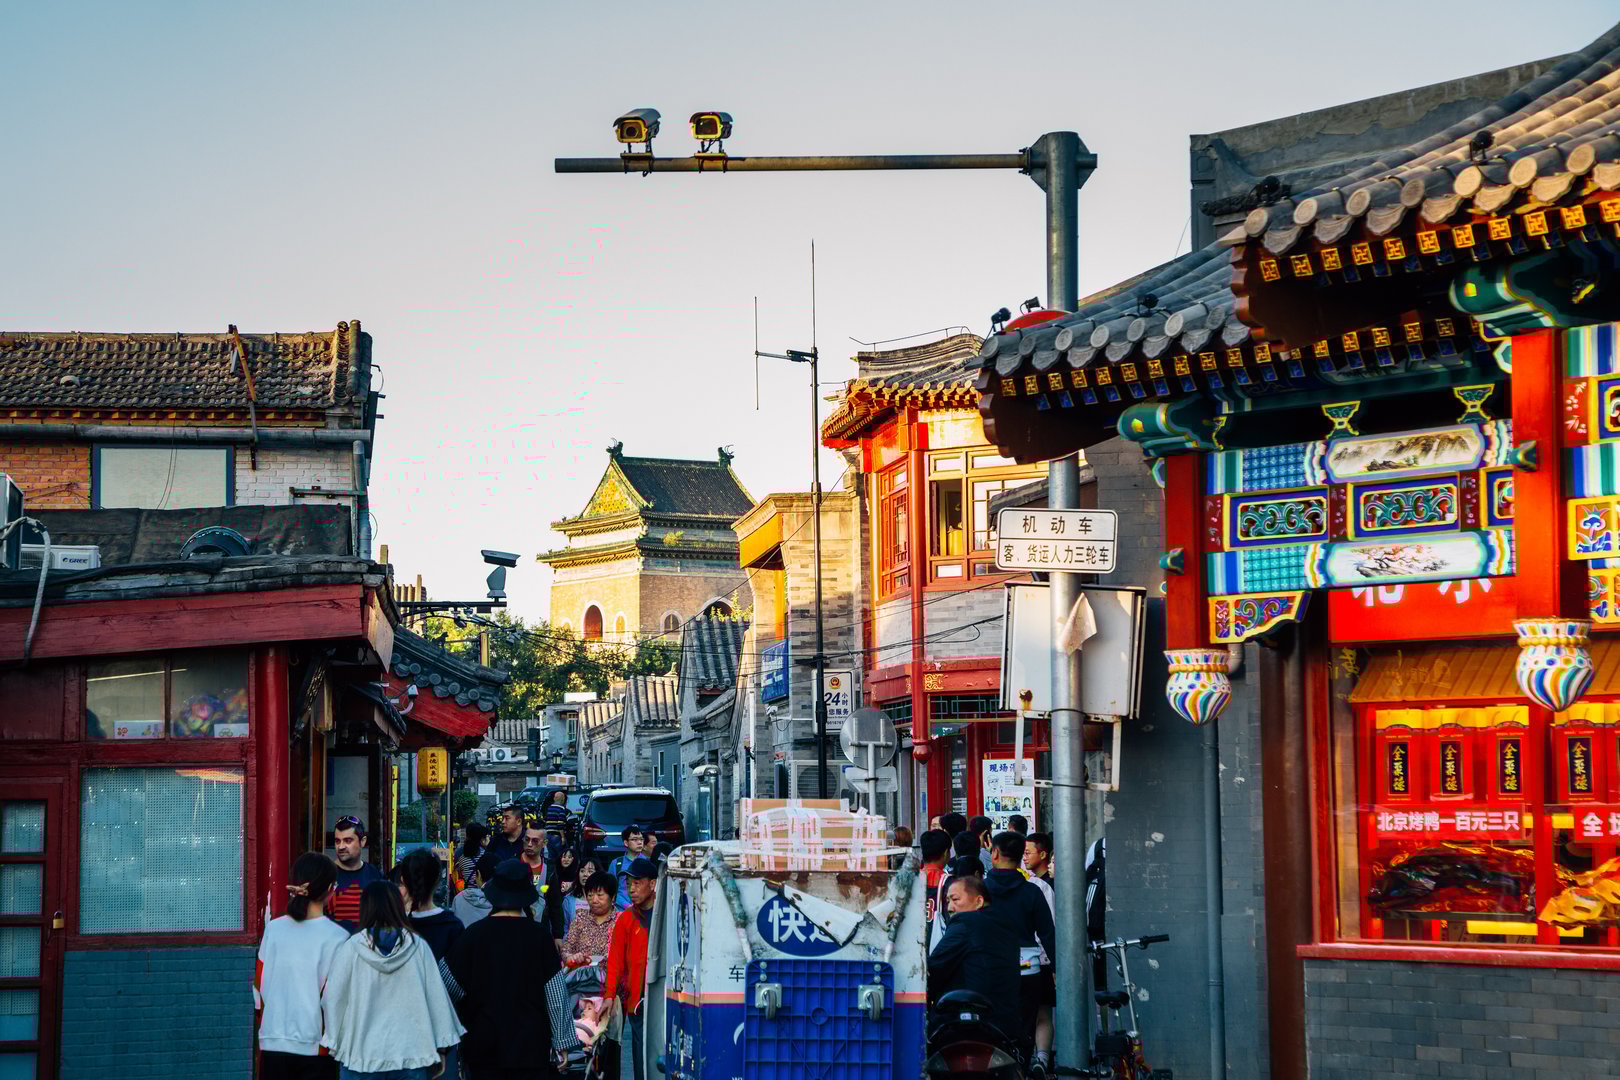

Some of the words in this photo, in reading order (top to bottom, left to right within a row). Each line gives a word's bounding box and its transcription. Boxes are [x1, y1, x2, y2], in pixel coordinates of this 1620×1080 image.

[1022, 515, 1093, 535] 机动车
[1003, 544, 1109, 565] 客、货运人力三轮车
[824, 692, 841, 706] 24
[841, 692, 849, 706] 小时
[827, 708, 849, 716] 您服务
[1376, 811, 1520, 832] 北京烤鸭一百元三只
